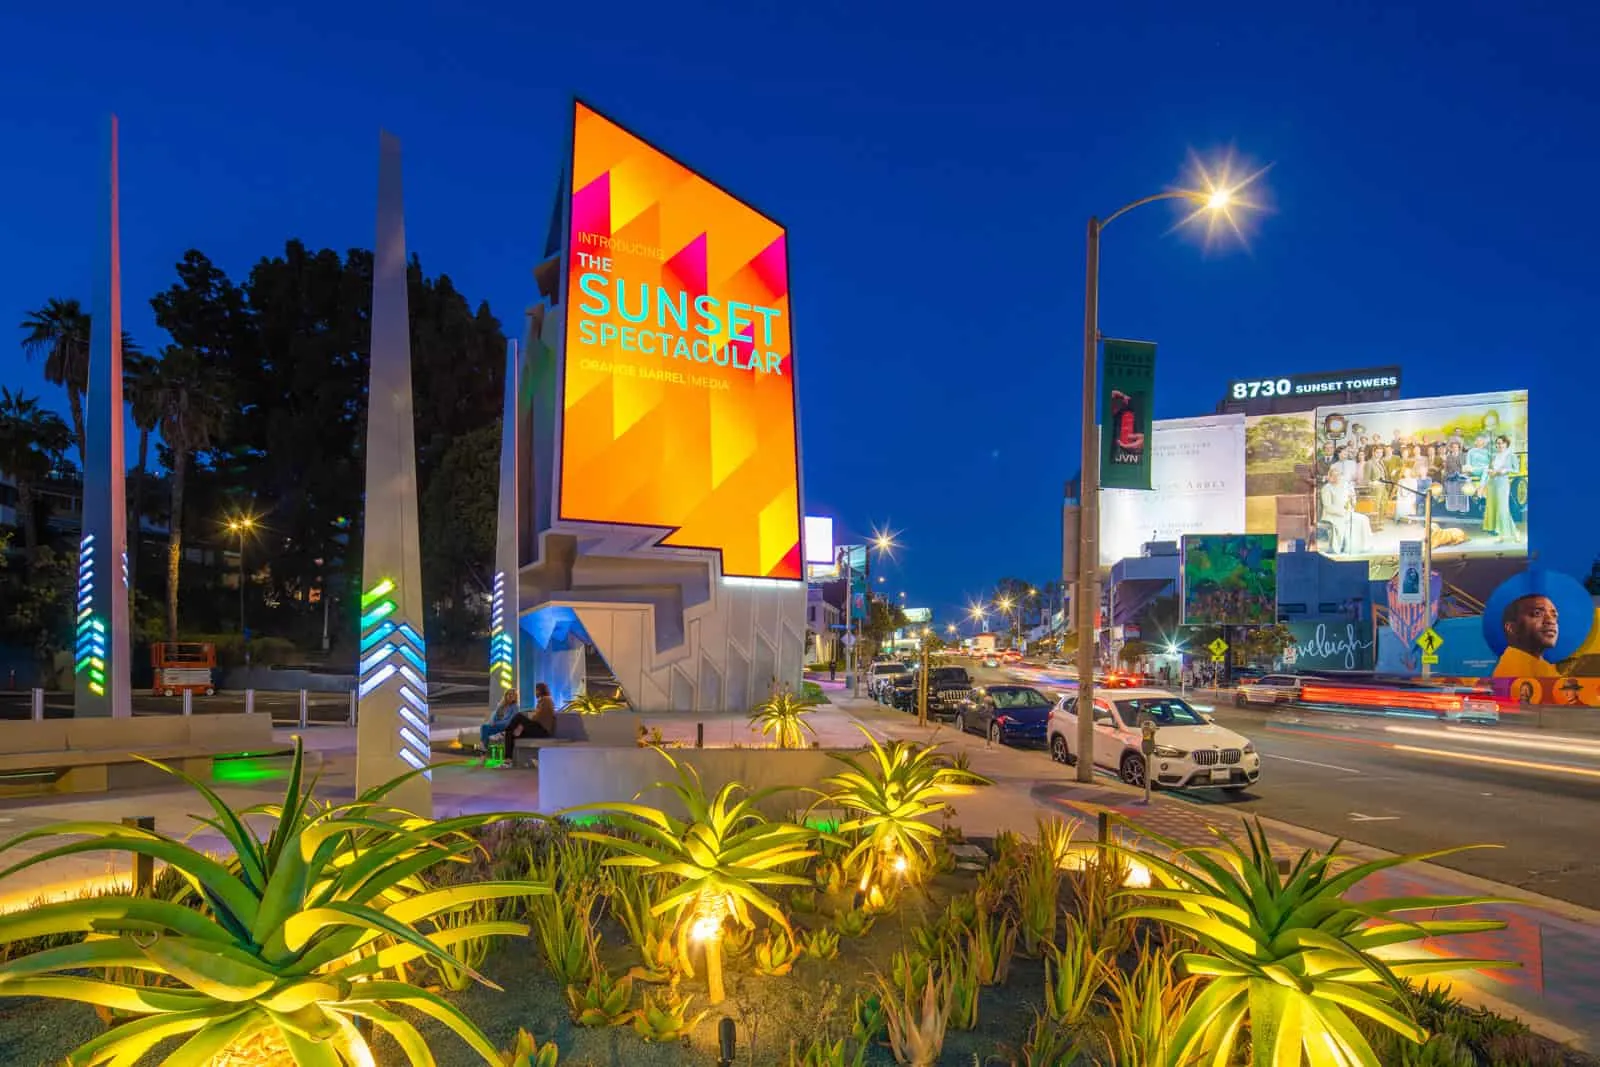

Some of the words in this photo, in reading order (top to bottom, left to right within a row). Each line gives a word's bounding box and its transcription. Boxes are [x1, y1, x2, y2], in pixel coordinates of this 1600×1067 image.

[577, 231, 665, 260] INTRODUCING
[577, 252, 612, 272] THE
[579, 273, 781, 346] SUNSET
[579, 319, 782, 375] SPECTACULAR
[580, 359, 636, 376] ORANGE
[1233, 379, 1291, 398] 8730
[1295, 383, 1343, 393] SUNSET
[1345, 376, 1397, 389] TOWERS
[1115, 454, 1139, 465] JVN
